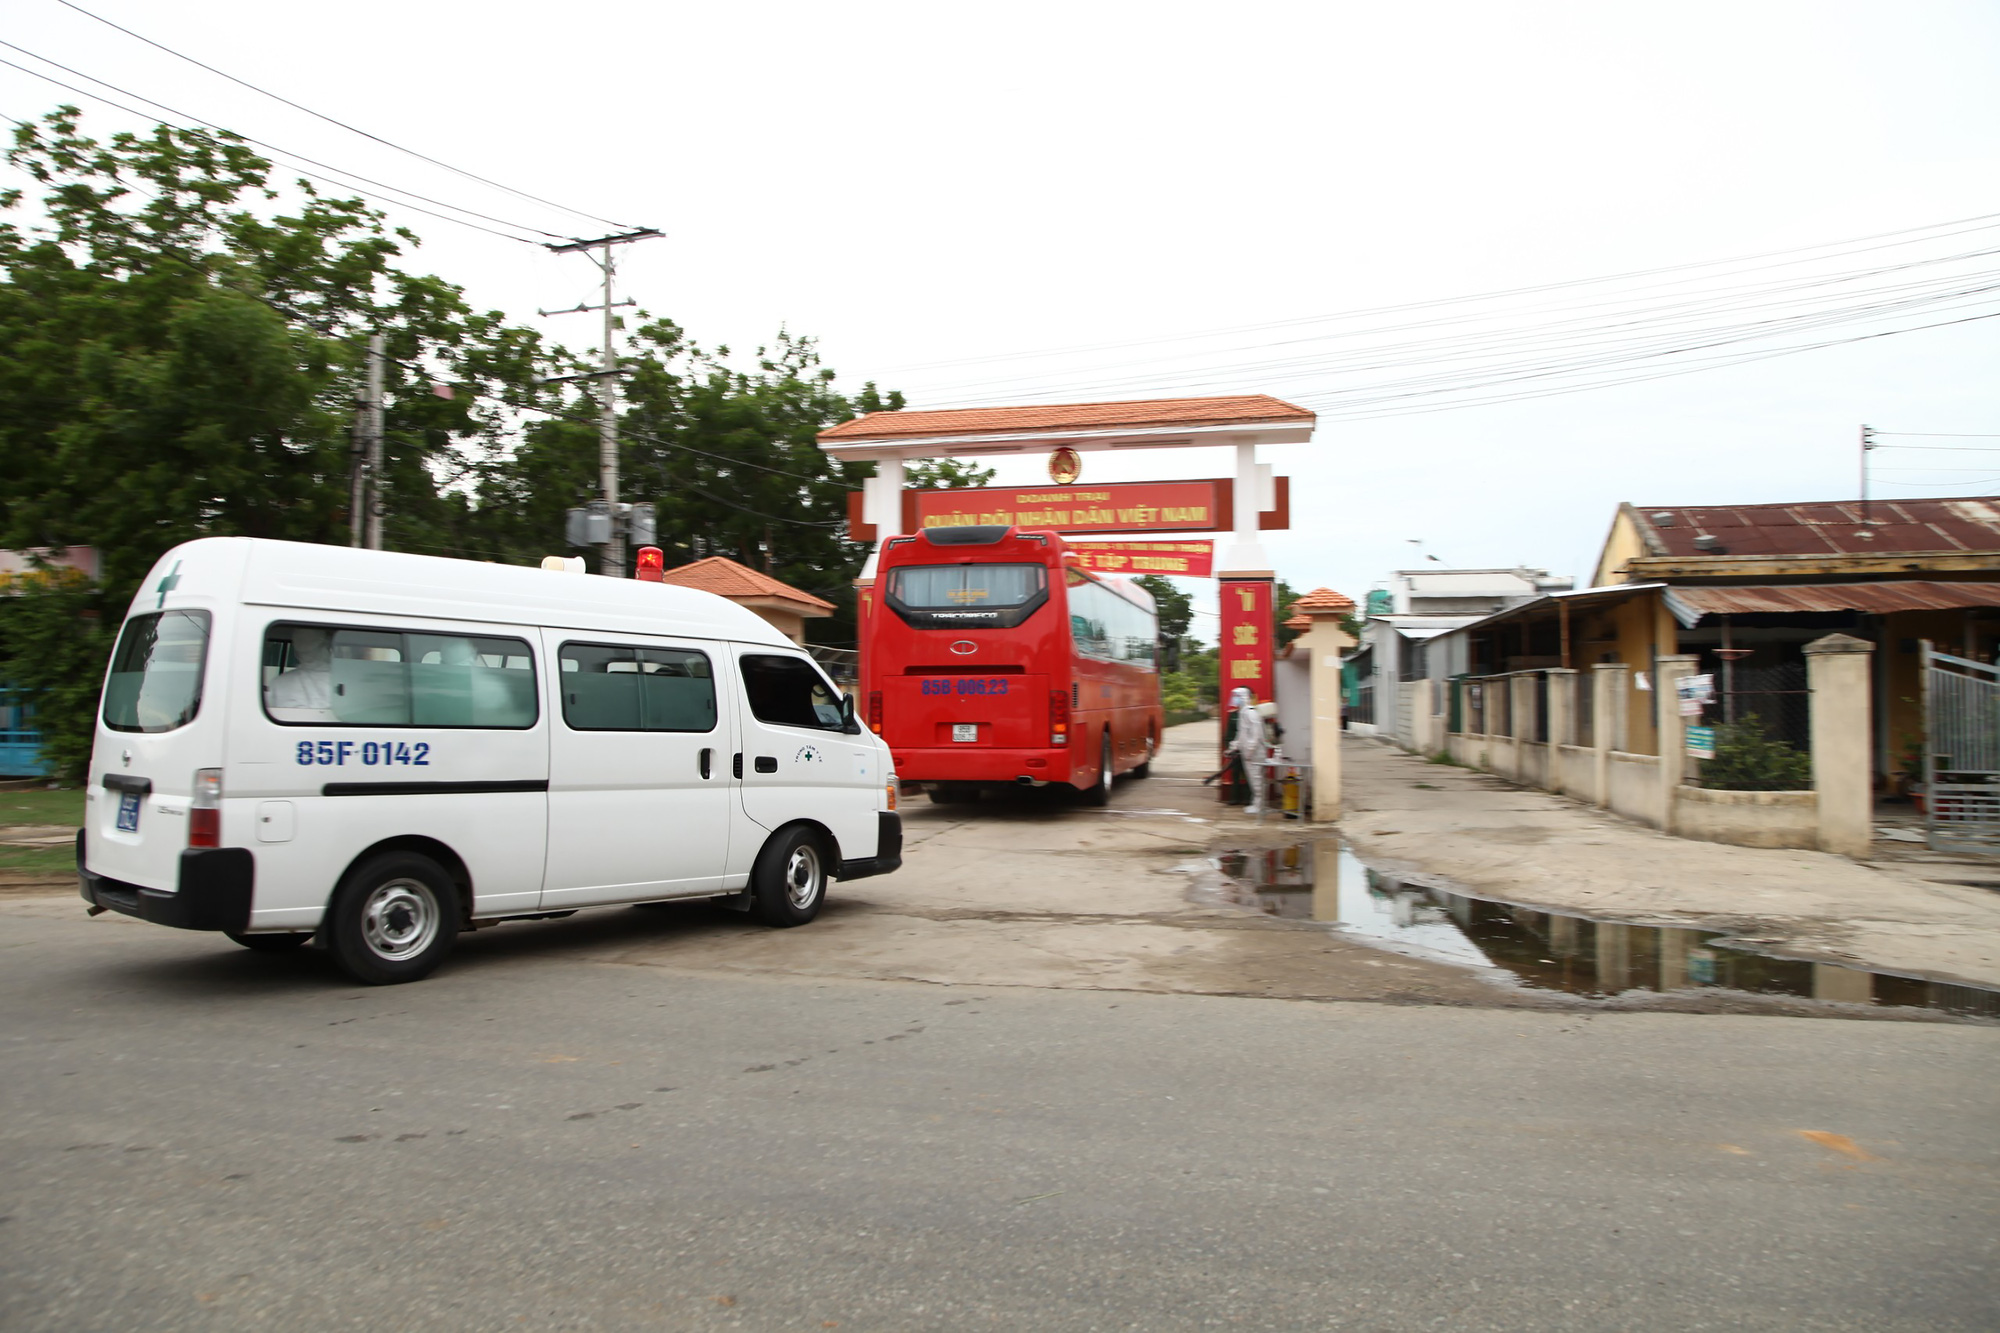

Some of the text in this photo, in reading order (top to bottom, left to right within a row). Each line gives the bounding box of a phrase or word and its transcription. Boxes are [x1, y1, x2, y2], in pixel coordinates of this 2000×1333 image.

[1016, 492, 1110, 503] DOANH TRẠI
[924, 510, 977, 528] QUÂN
[1016, 507, 1070, 526] NHÂN
[1072, 506, 1115, 525] DÂN
[1117, 504, 1159, 526] VIỆT
[1160, 506, 1207, 522] NAM
[1093, 552, 1128, 571] TẬP
[1129, 555, 1189, 572] TRUNG
